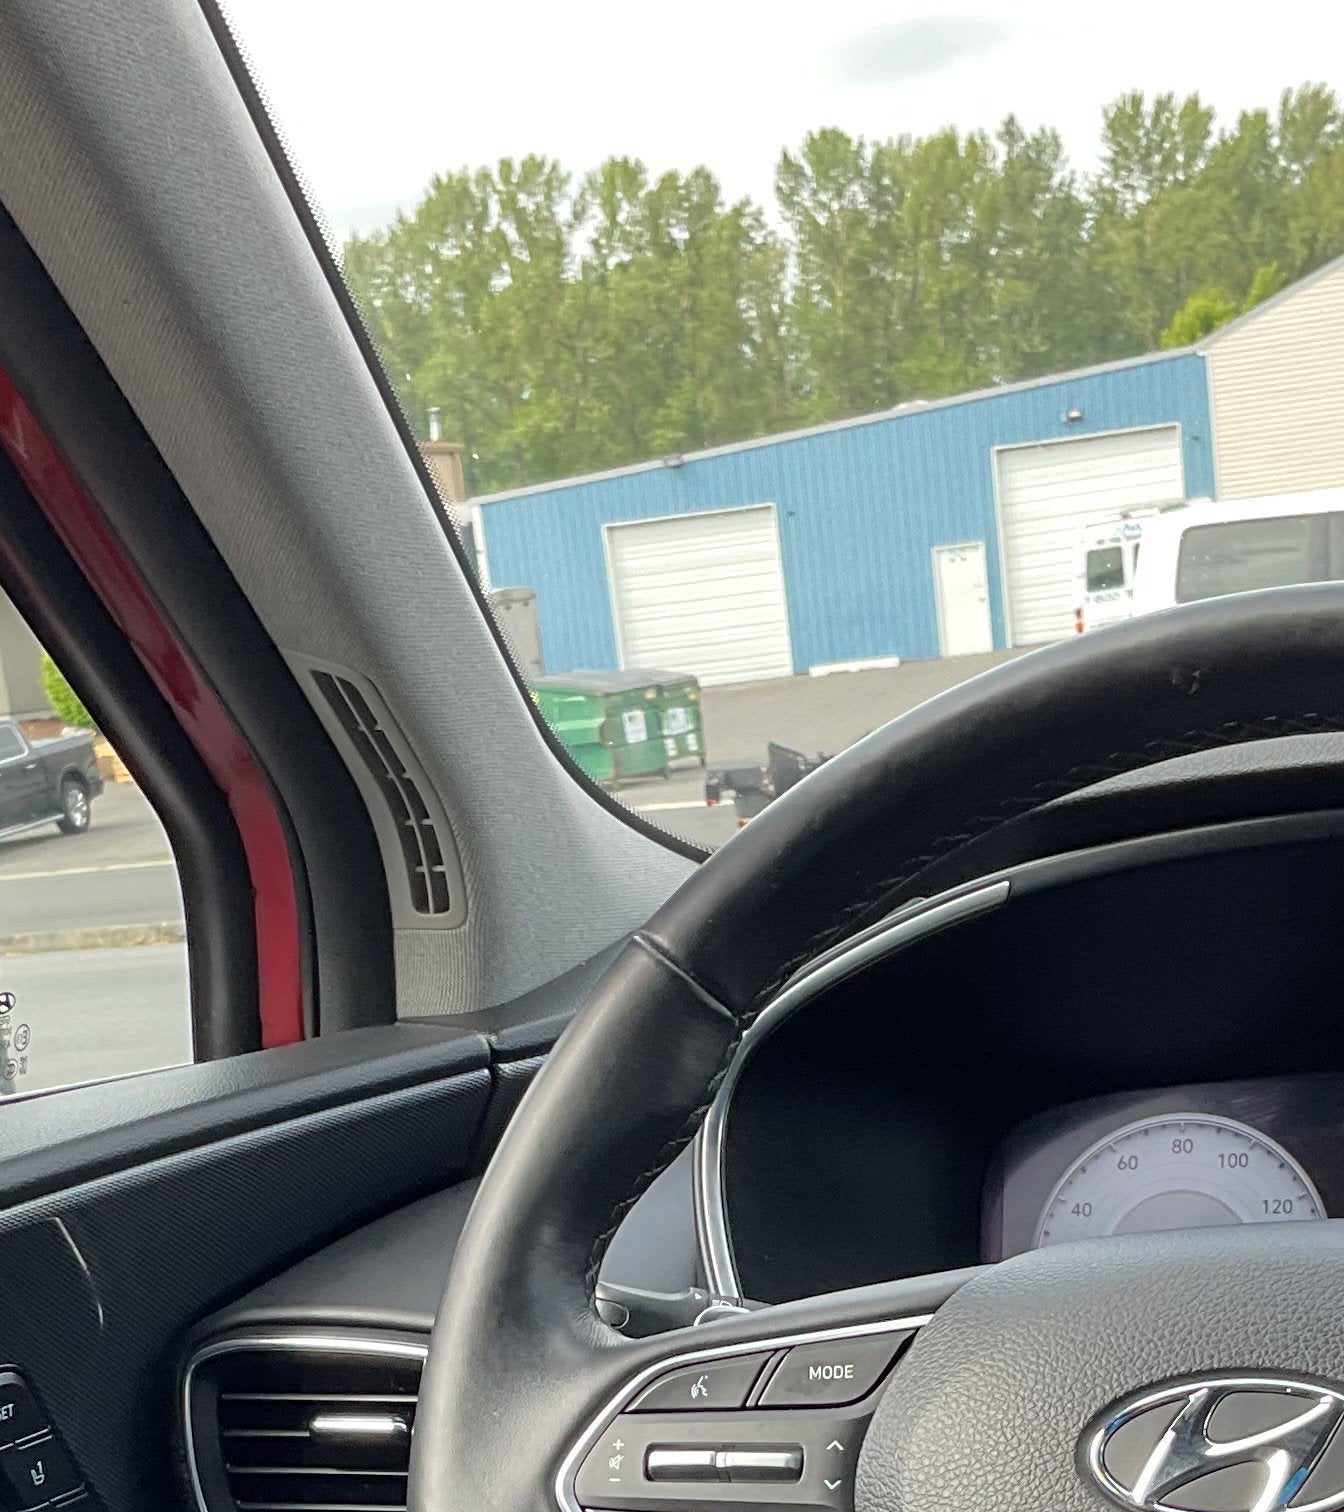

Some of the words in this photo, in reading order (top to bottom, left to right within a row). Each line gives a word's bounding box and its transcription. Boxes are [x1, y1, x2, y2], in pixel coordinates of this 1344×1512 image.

[1171, 1138, 1193, 1154] 80
[1116, 1155, 1138, 1170] 60
[1218, 1152, 1249, 1168] 100
[1070, 1202, 1092, 1217] 40
[1262, 1199, 1294, 1214] 120
[809, 1364, 854, 1380] MODE
